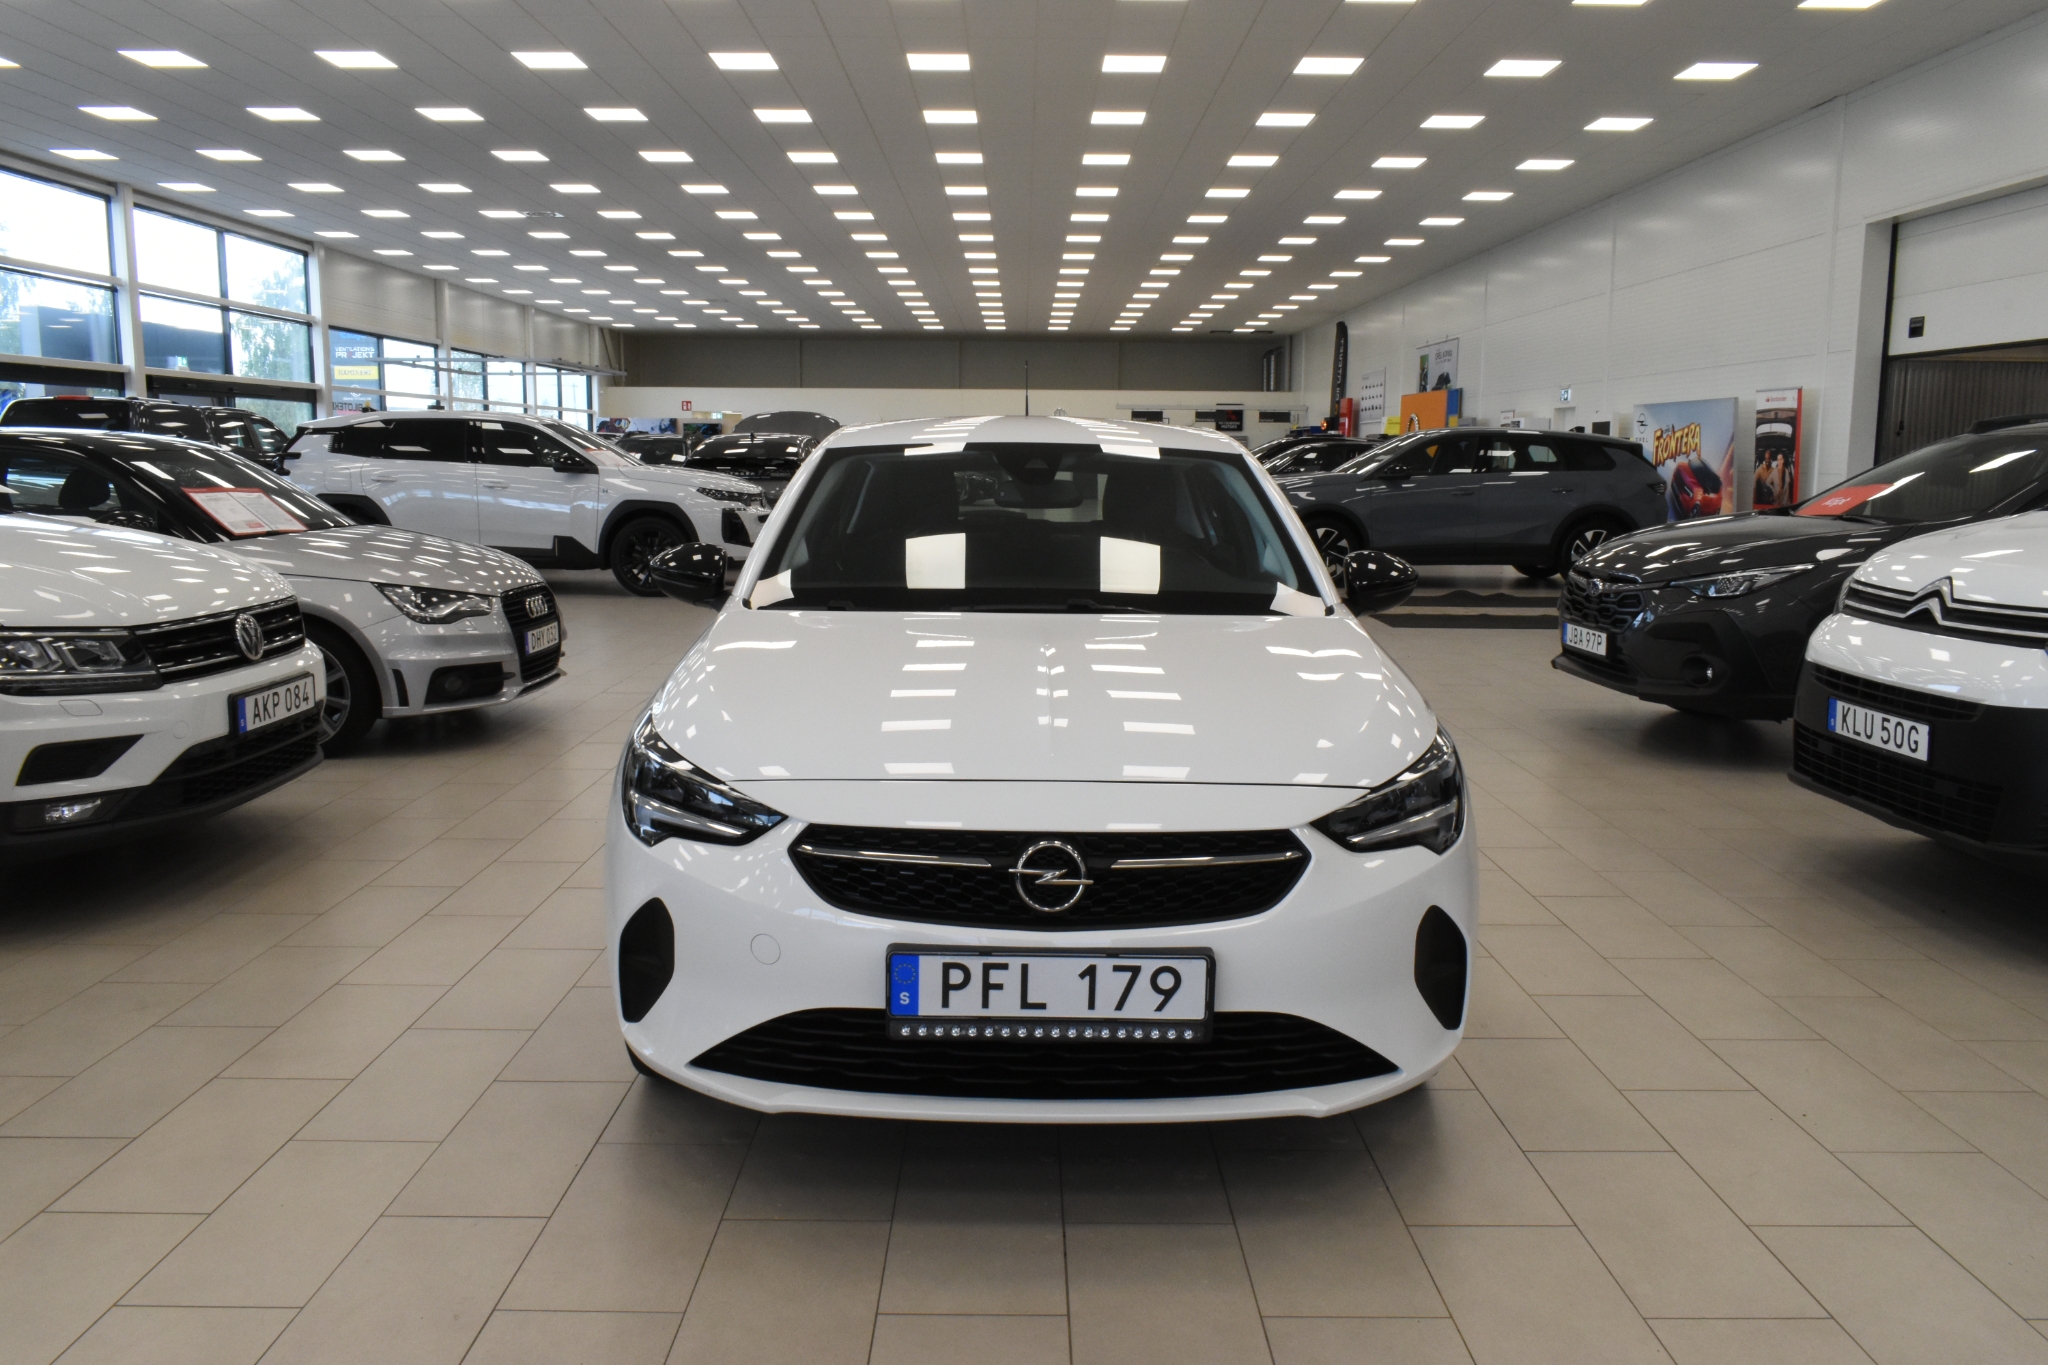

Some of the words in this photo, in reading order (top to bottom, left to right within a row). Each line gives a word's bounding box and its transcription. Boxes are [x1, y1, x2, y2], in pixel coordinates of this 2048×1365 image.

[1652, 421, 1702, 467] FRONTERA
[531, 629, 546, 650] DHY
[1569, 626, 1583, 647] JBA
[1585, 631, 1603, 652] 97P
[252, 691, 280, 725] AKP
[284, 681, 309, 712] 084
[1841, 705, 1874, 740] KLU
[1880, 716, 1920, 754] 50G
[899, 992, 910, 1005] S
[941, 961, 1047, 1010] PFL
[1078, 964, 1182, 1012] 179
